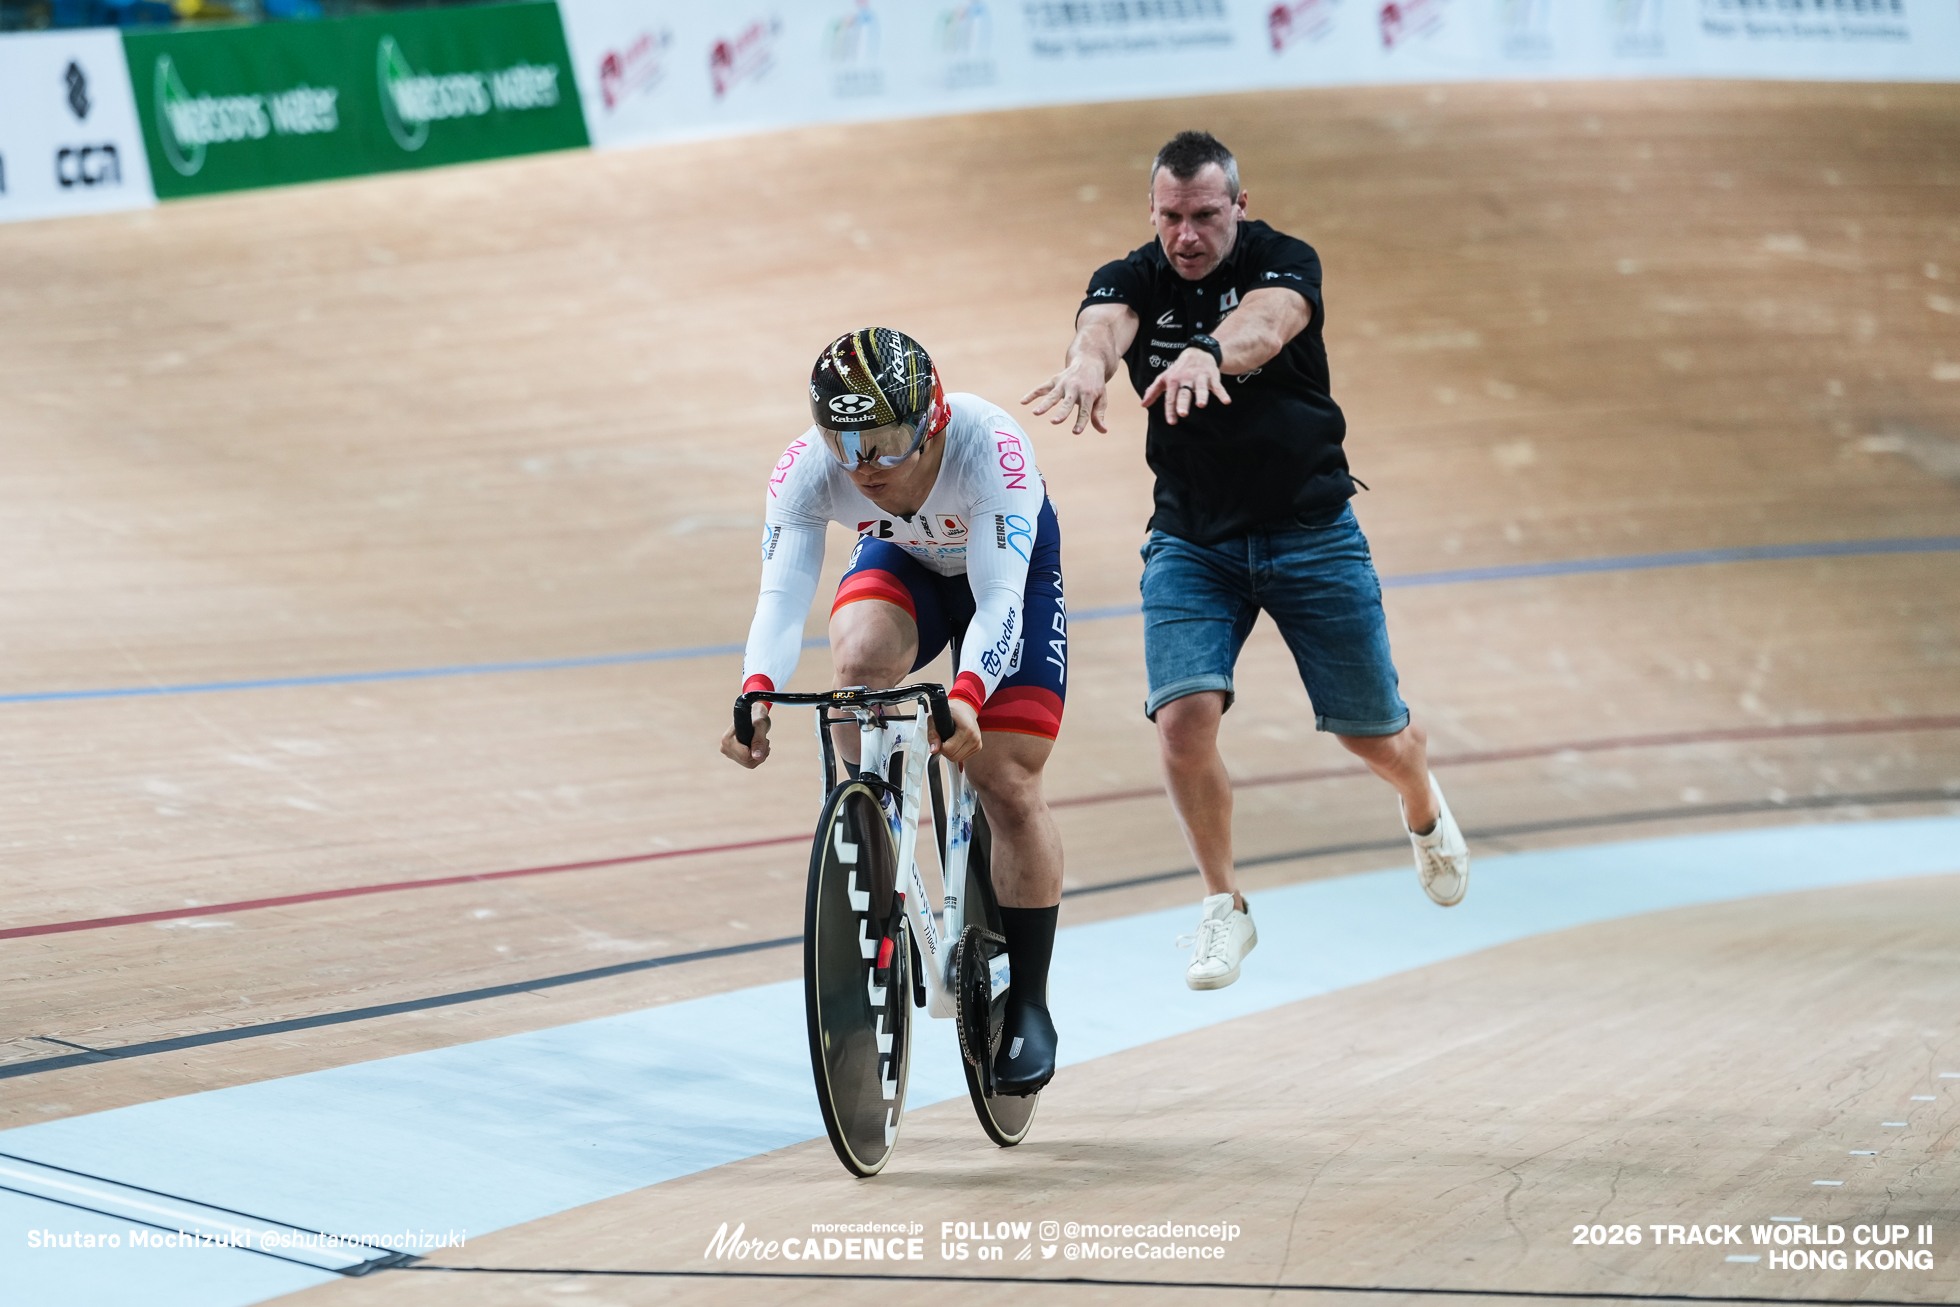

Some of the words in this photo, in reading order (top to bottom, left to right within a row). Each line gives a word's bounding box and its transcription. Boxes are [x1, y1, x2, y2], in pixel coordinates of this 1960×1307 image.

[831, 414, 876, 423] Kabuto
[767, 526, 781, 560] KEIRIN
[995, 514, 1007, 549] KEIRIN
[996, 607, 1016, 655] Cyclers
[1046, 571, 1067, 685] JAPAN
